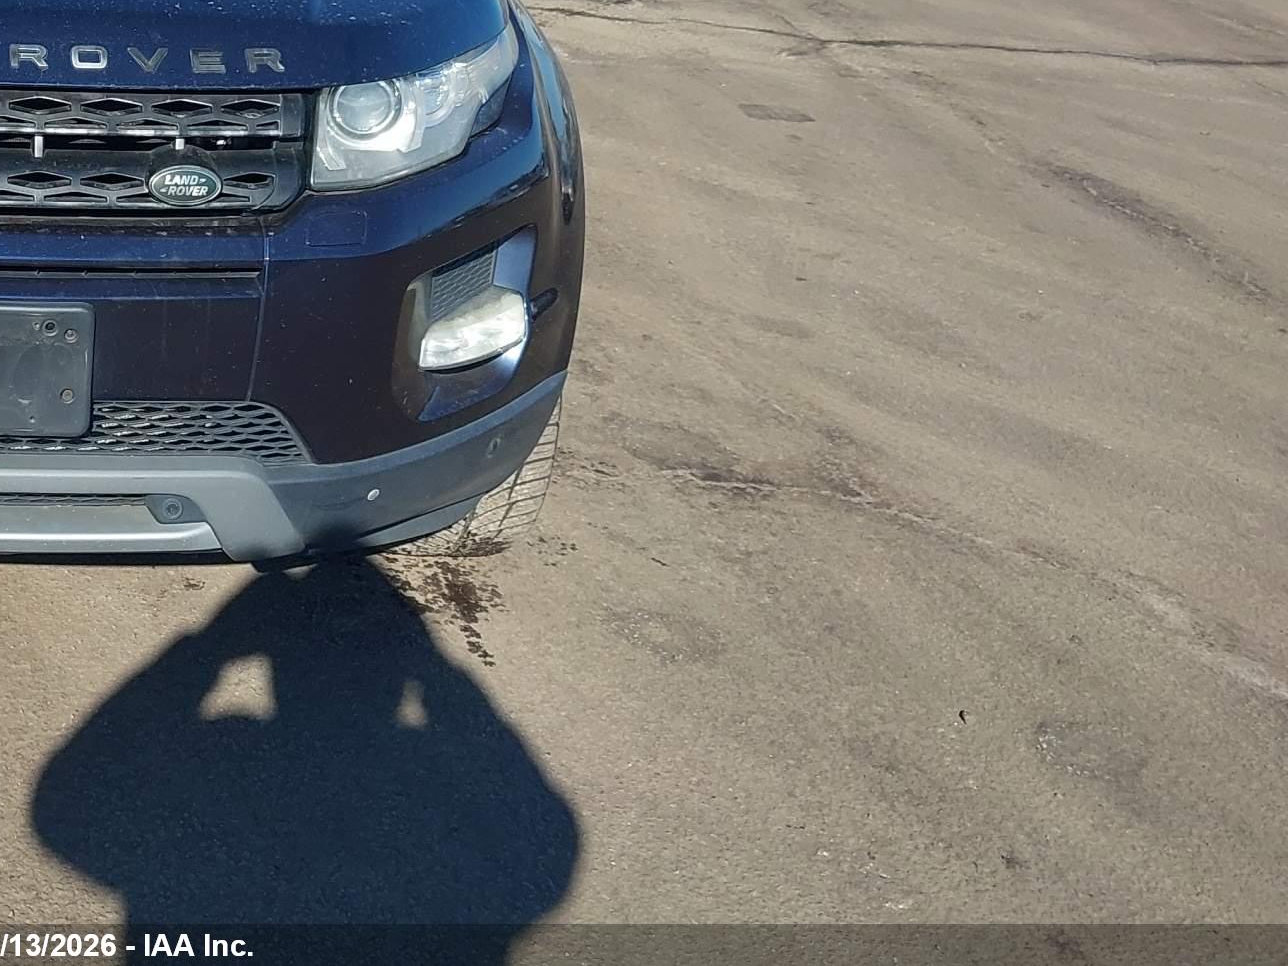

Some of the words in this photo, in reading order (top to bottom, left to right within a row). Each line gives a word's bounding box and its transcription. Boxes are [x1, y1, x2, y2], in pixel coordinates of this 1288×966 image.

[9, 43, 285, 74] ROVER
[164, 174, 199, 185] LAND
[167, 185, 209, 196] ROVER
